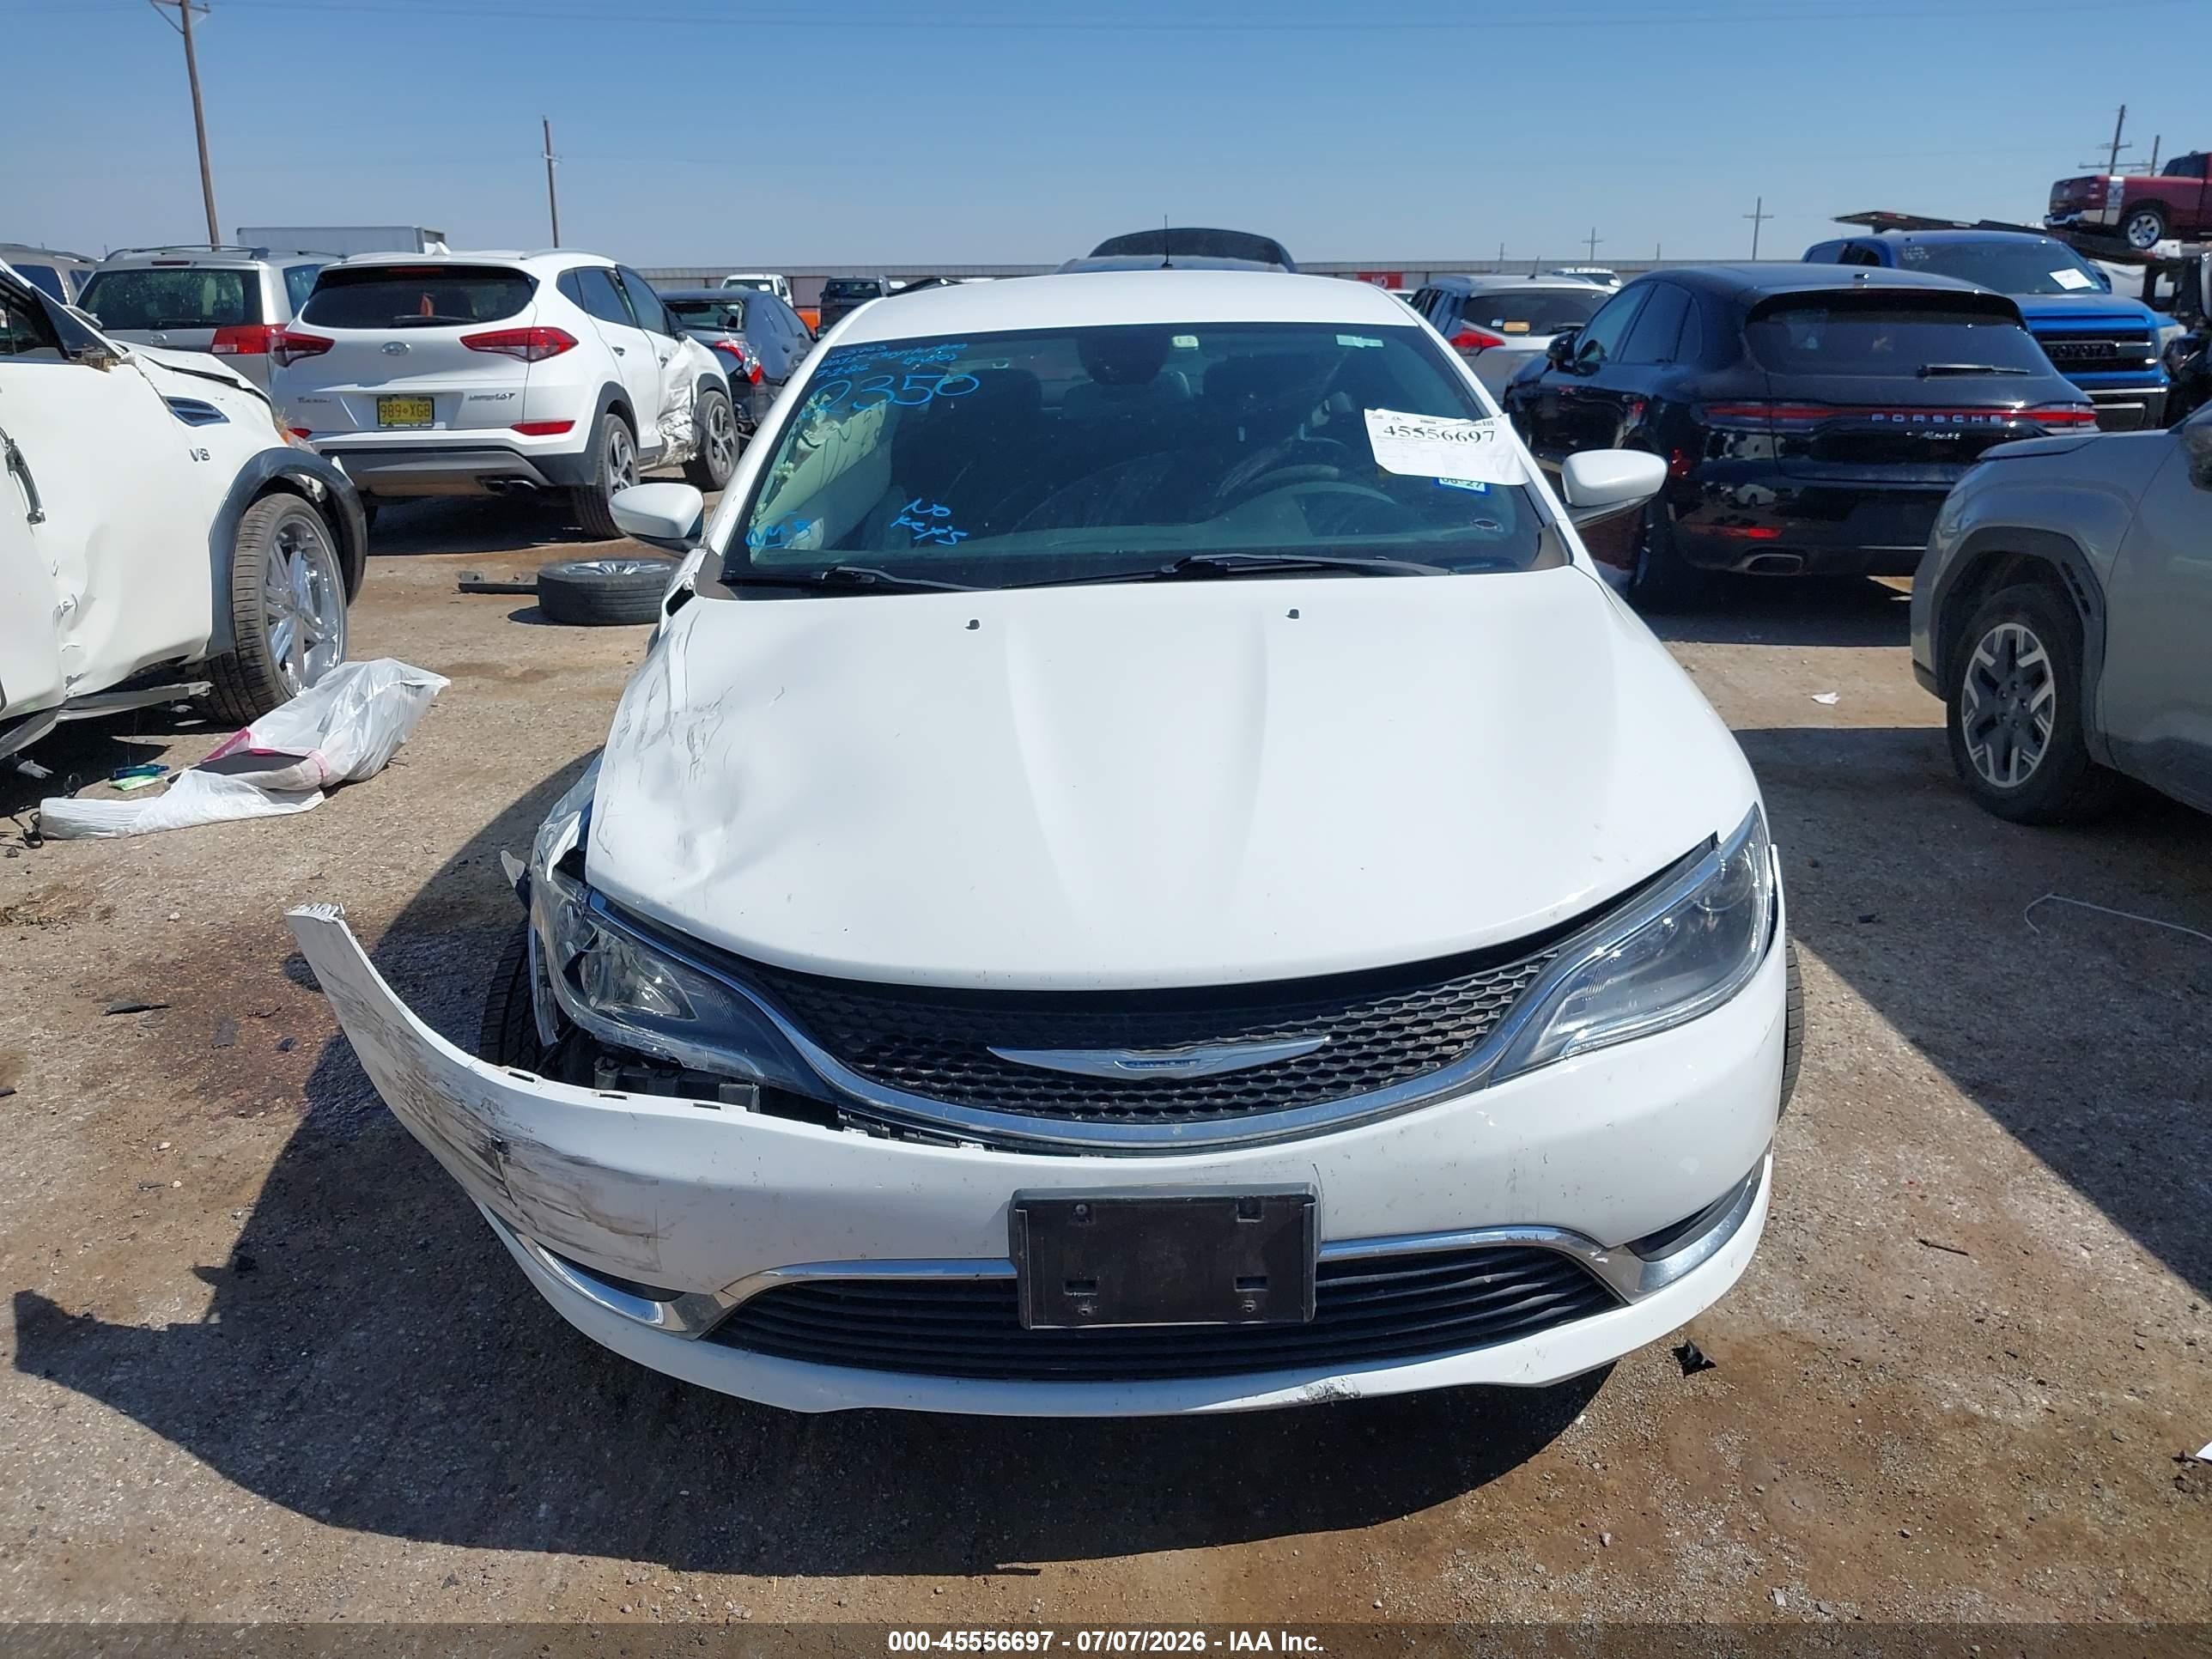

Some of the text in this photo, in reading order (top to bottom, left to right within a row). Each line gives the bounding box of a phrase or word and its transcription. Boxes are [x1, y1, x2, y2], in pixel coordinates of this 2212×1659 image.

[1871, 414, 2002, 423] PORSCHE
[1382, 425, 1496, 444] 45556697
[189, 447, 210, 462] V8
